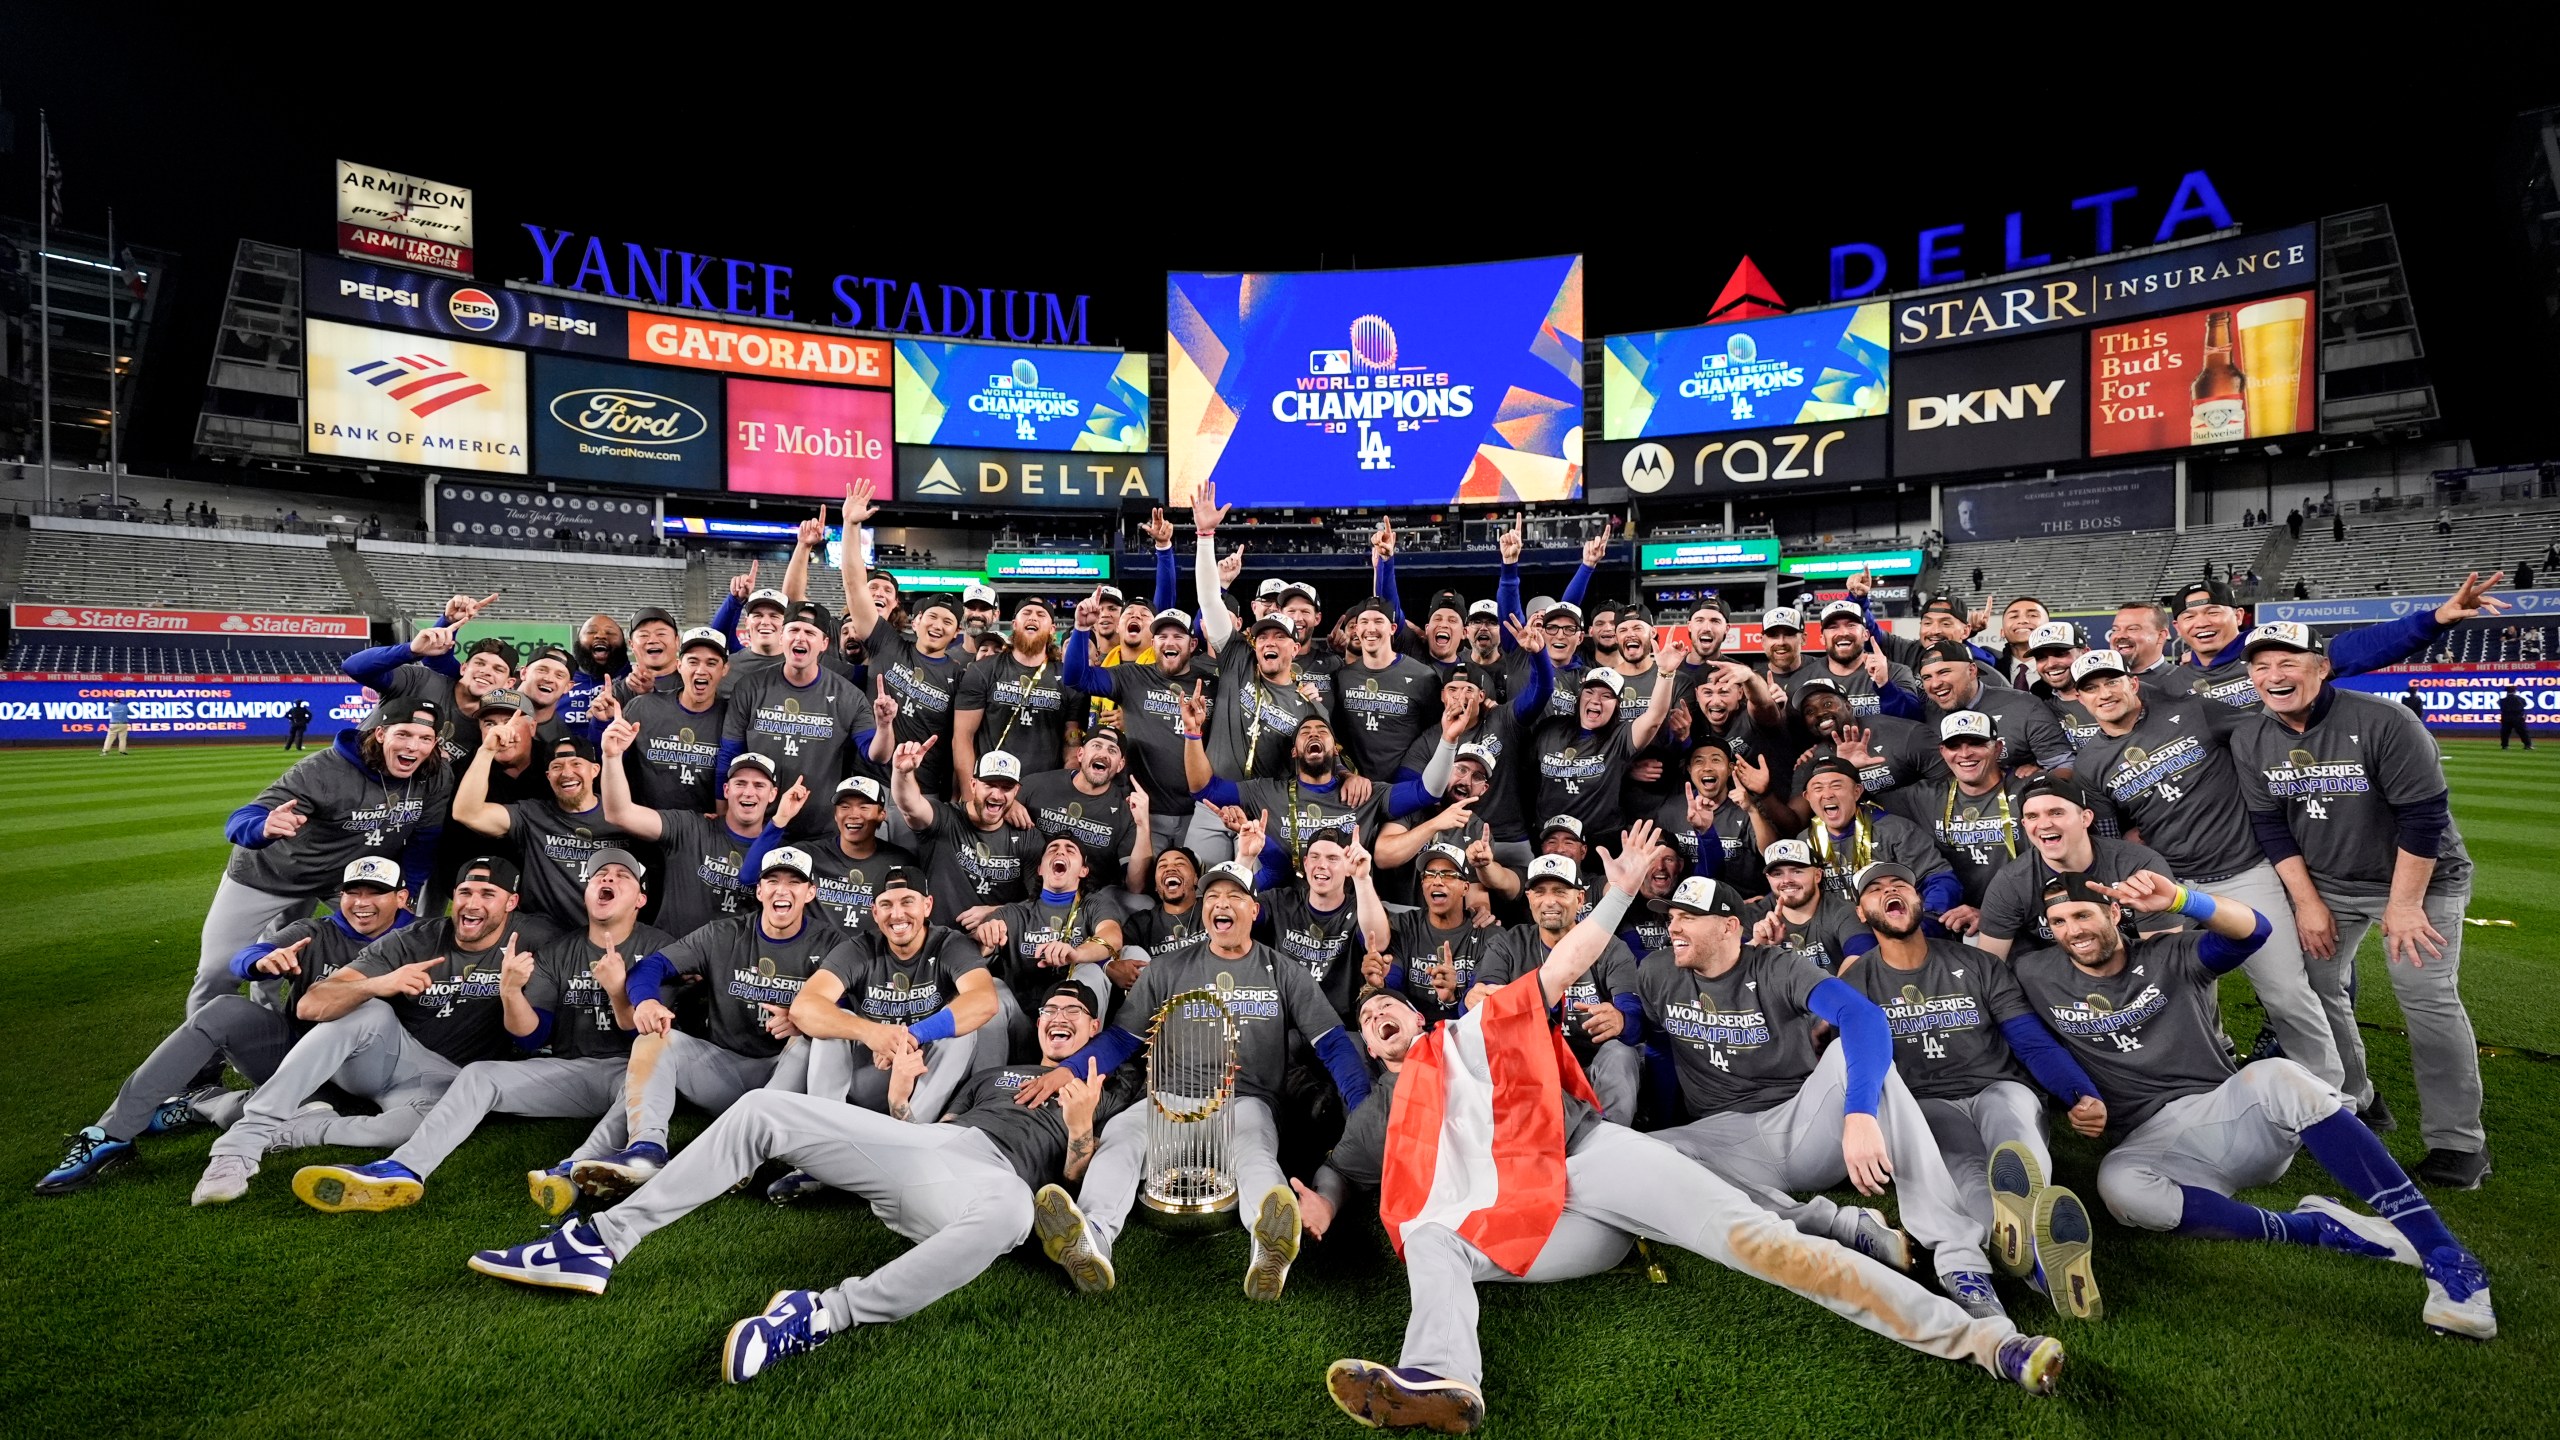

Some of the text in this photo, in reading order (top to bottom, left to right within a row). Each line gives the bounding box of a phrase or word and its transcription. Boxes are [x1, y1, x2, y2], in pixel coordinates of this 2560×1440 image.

[343, 172, 465, 209] ARMITRON
[351, 229, 459, 261] ARMITRON
[1829, 169, 2234, 301] DELTA
[406, 251, 458, 268] WATCHES
[340, 279, 418, 308] PEPSI
[522, 223, 1090, 346] YANKEE STADIUM
[1900, 244, 2305, 344] STARR INSURANCE
[453, 302, 495, 317] PEPSI
[529, 312, 597, 336] PEPSI
[646, 324, 880, 378] GATORADE
[2100, 329, 2168, 355] This
[1694, 361, 1788, 379] WORLD SERIES
[2100, 350, 2183, 379] Bud's
[1297, 373, 1449, 390] WORLD SERIES
[1679, 367, 1804, 398] CHAMPIONS
[2100, 378, 2151, 401] For
[982, 388, 1065, 399] WORLD SERIES
[1272, 385, 1473, 422] CHAMPIONS
[579, 394, 681, 437] Ford
[968, 394, 1079, 417] CHAMPIONS
[1731, 391, 1753, 420] LA
[1908, 380, 2066, 431] DKNY
[2100, 401, 2165, 425] You.
[1016, 413, 1036, 440] LA
[1325, 420, 1420, 433] 20 24
[2193, 427, 2243, 440] Budweiser
[314, 422, 521, 456] BANK OF AMERICA
[775, 424, 883, 460] Mobile
[1357, 420, 1394, 470] LA
[579, 443, 681, 462] BuyFordNow.com
[1694, 431, 1845, 486] razr
[979, 462, 1149, 496] DELTA
[2024, 492, 2055, 500] GEORGE
[2069, 484, 2129, 496] STEINBRENNER
[505, 507, 593, 526] New York Yankees
[2041, 516, 2122, 533] THE BOSS
[1467, 543, 1497, 551] StubHub
[1816, 590, 1907, 600] TOYO ERRACE
[2298, 606, 2359, 616] FANDUEL
[2410, 664, 2433, 672] BUDS
[2476, 662, 2536, 671] HIT THE BUDS
[80, 674, 103, 682] BUDS
[892, 662, 950, 703] WORLD SERIES
[79, 689, 232, 698] CONGRATULATIONS
[885, 670, 948, 712] CHAMPIONS
[1030, 690, 1061, 700] SERIES
[1345, 690, 1409, 704] WORLD SERIES
[0, 701, 42, 720] 024
[127, 701, 194, 719] SERIES
[1344, 698, 1408, 715] CHAMPIONS
[62, 722, 247, 732] LOS AELES DODGERS
[756, 709, 833, 727] WORLD SERIES
[1366, 711, 1379, 731] LA
[754, 719, 833, 739] CHAMPIONS
[650, 738, 690, 752] WORLD
[784, 735, 798, 756] LA
[1540, 762, 1606, 778] CHAMPIONS
[1542, 753, 1604, 767] WORLD SERIES
[2107, 736, 2198, 790] WORLD SERIES
[680, 764, 695, 785] LA
[2113, 745, 2207, 801] CHAMPIONS
[2310, 764, 2365, 777] SERIES
[1564, 778, 1580, 794] LA
[2268, 776, 2369, 796] CHAMPIONS
[1040, 809, 1113, 836] WORLD SERIES
[1319, 812, 1356, 827] SERIES
[545, 835, 592, 849] WORLD
[989, 857, 1021, 868] SERIES
[819, 877, 854, 890] WORLD
[843, 905, 859, 928] LA
[1286, 929, 1321, 949] WORLD
[868, 986, 906, 1001] WORLD
[1235, 990, 1279, 1001] SERIES
[861, 992, 943, 1016] CHAMPIONS
[1925, 996, 1976, 1012] SERIES
[2055, 994, 2168, 1034] CHAMPIONS
[1666, 1004, 1765, 1029] WORLD SERIES
[1889, 1009, 1980, 1034] HAMPIONS
[1665, 1019, 1770, 1044] CHAMPIONS
[1922, 1032, 1947, 1059] LA
[1708, 1043, 1730, 1073] LA
